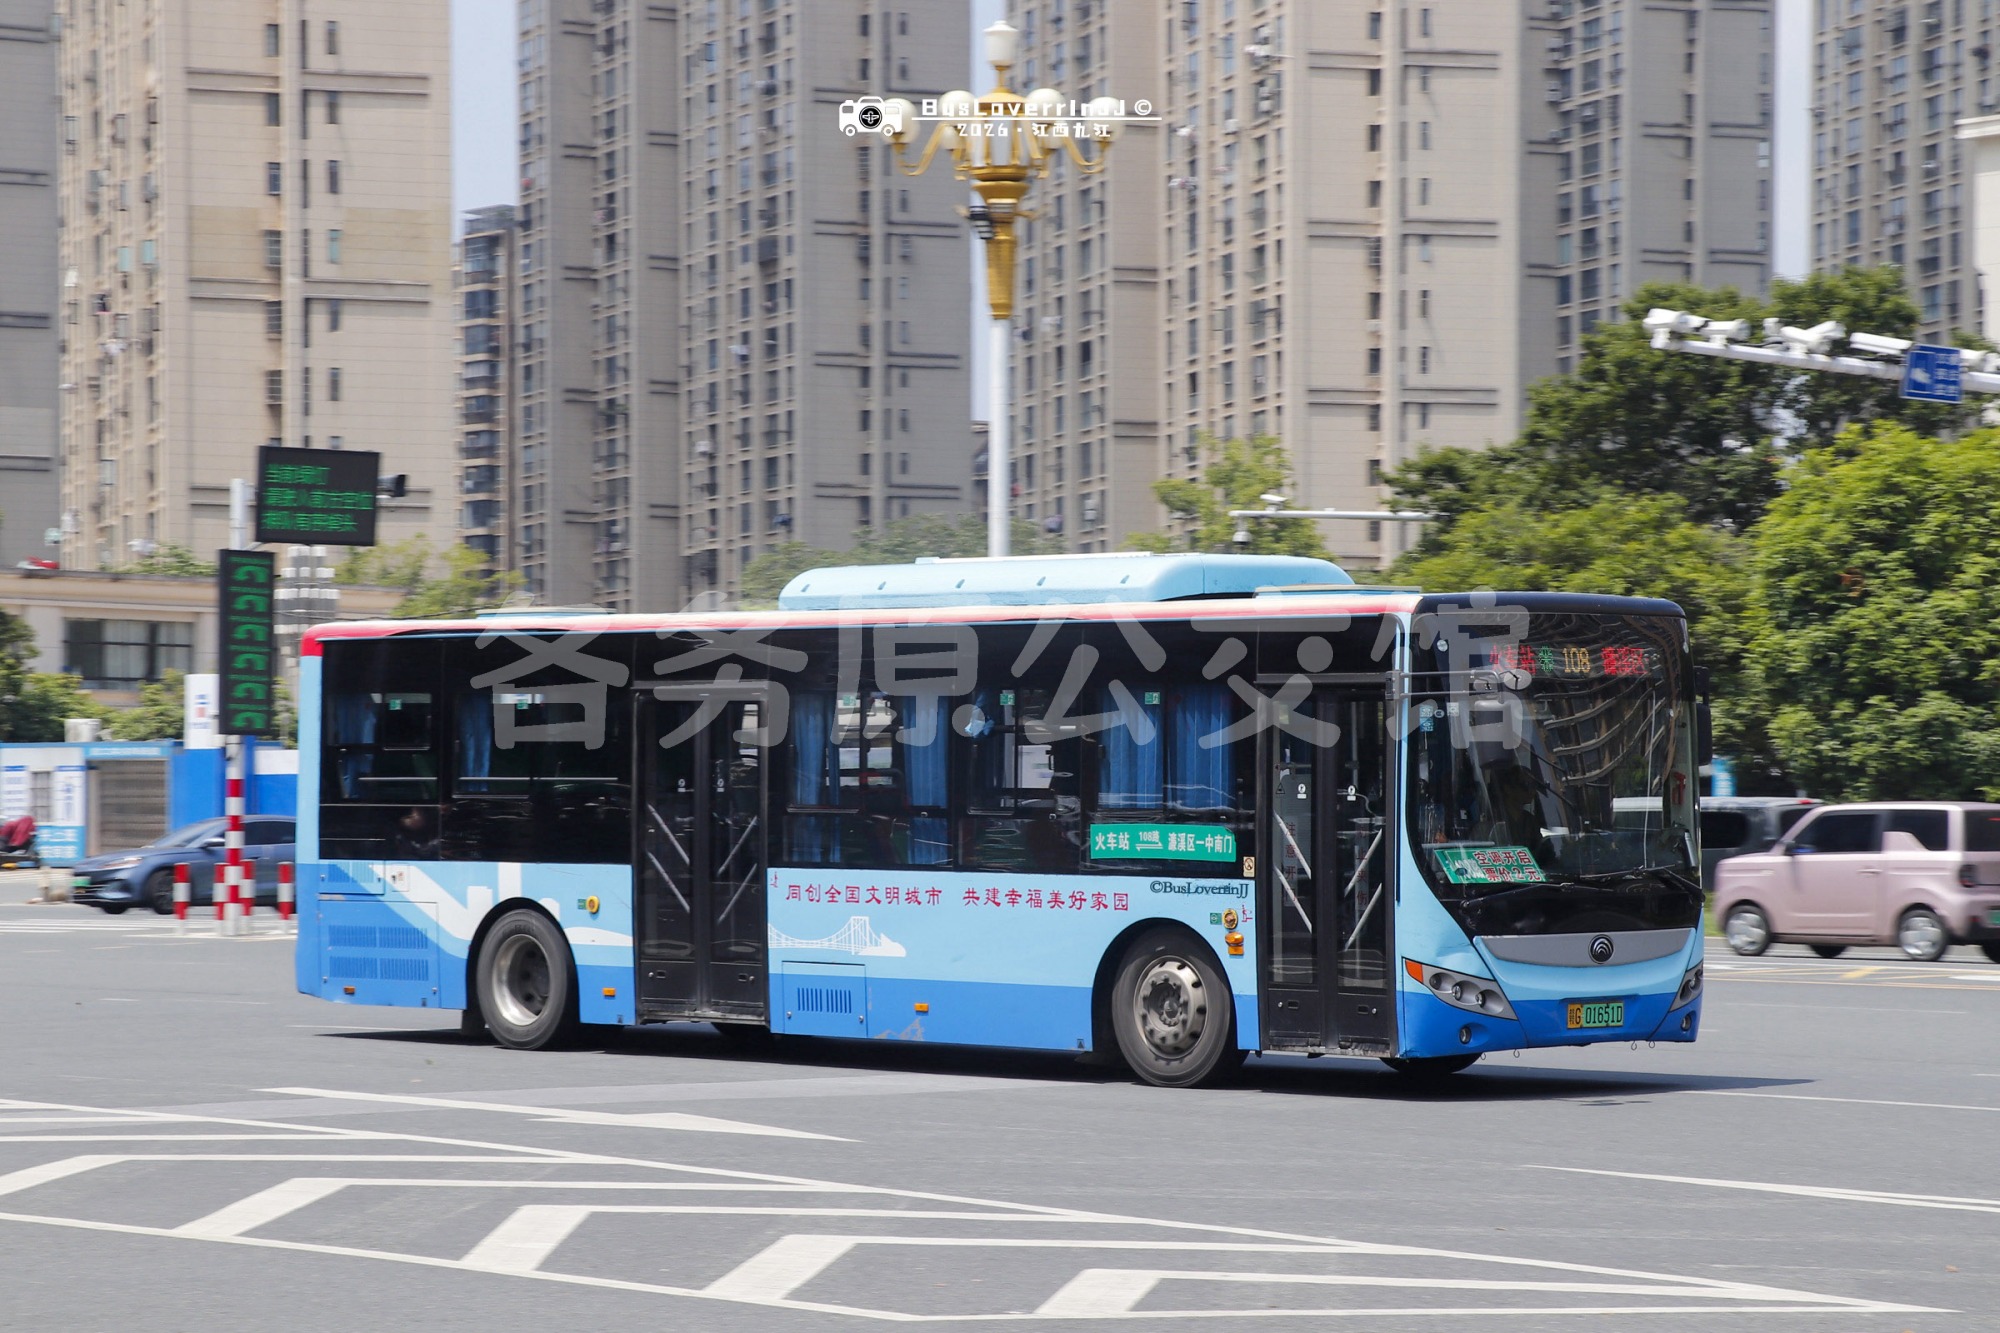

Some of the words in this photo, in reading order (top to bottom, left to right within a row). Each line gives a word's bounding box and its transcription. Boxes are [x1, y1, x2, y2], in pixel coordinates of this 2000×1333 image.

[1562, 648, 1591, 674] 108
[1095, 832, 1130, 851] 火车站
[1139, 831, 1159, 842] 108路
[1167, 832, 1233, 854] 濂溪区一中南门
[1474, 849, 1534, 865] 空调开启
[1483, 867, 1541, 882] 票价2元
[786, 883, 943, 906] 同创全国文明城市
[962, 886, 1129, 912] 共建幸福美好家园
